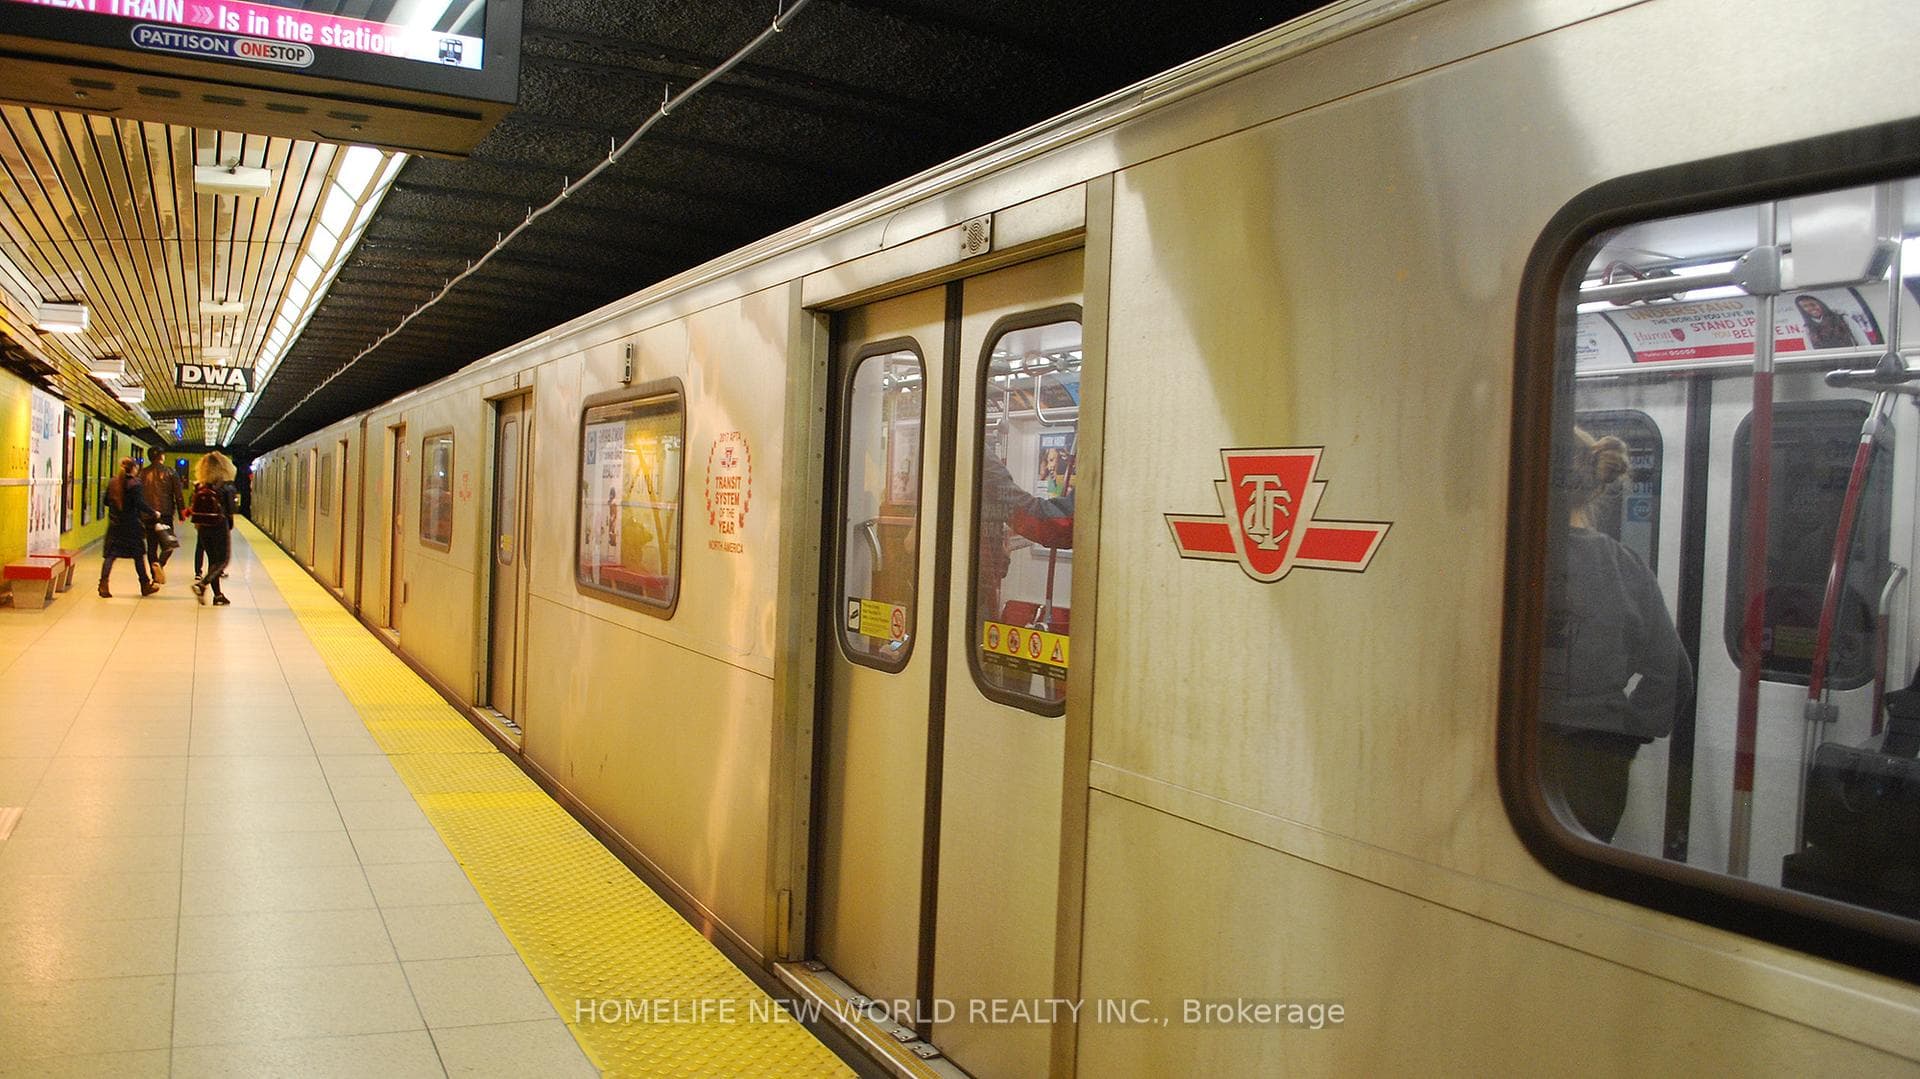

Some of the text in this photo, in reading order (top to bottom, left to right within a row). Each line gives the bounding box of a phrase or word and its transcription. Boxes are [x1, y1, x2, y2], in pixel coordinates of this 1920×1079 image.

[111, 0, 184, 24] TRAIN
[219, 6, 240, 32] Is
[248, 10, 269, 36] in
[276, 15, 313, 42] the
[140, 28, 305, 61] PATTISON ONESTOP
[1626, 301, 1744, 320] UNDERSTAND
[1671, 315, 1701, 323] WORLD
[1690, 317, 1757, 332] STAND UP
[1732, 326, 1785, 339] BELE
[182, 365, 248, 386] DWA
[715, 476, 742, 489] TRANSIT
[715, 492, 740, 505] SYSTEM
[718, 521, 735, 534] YEAR
